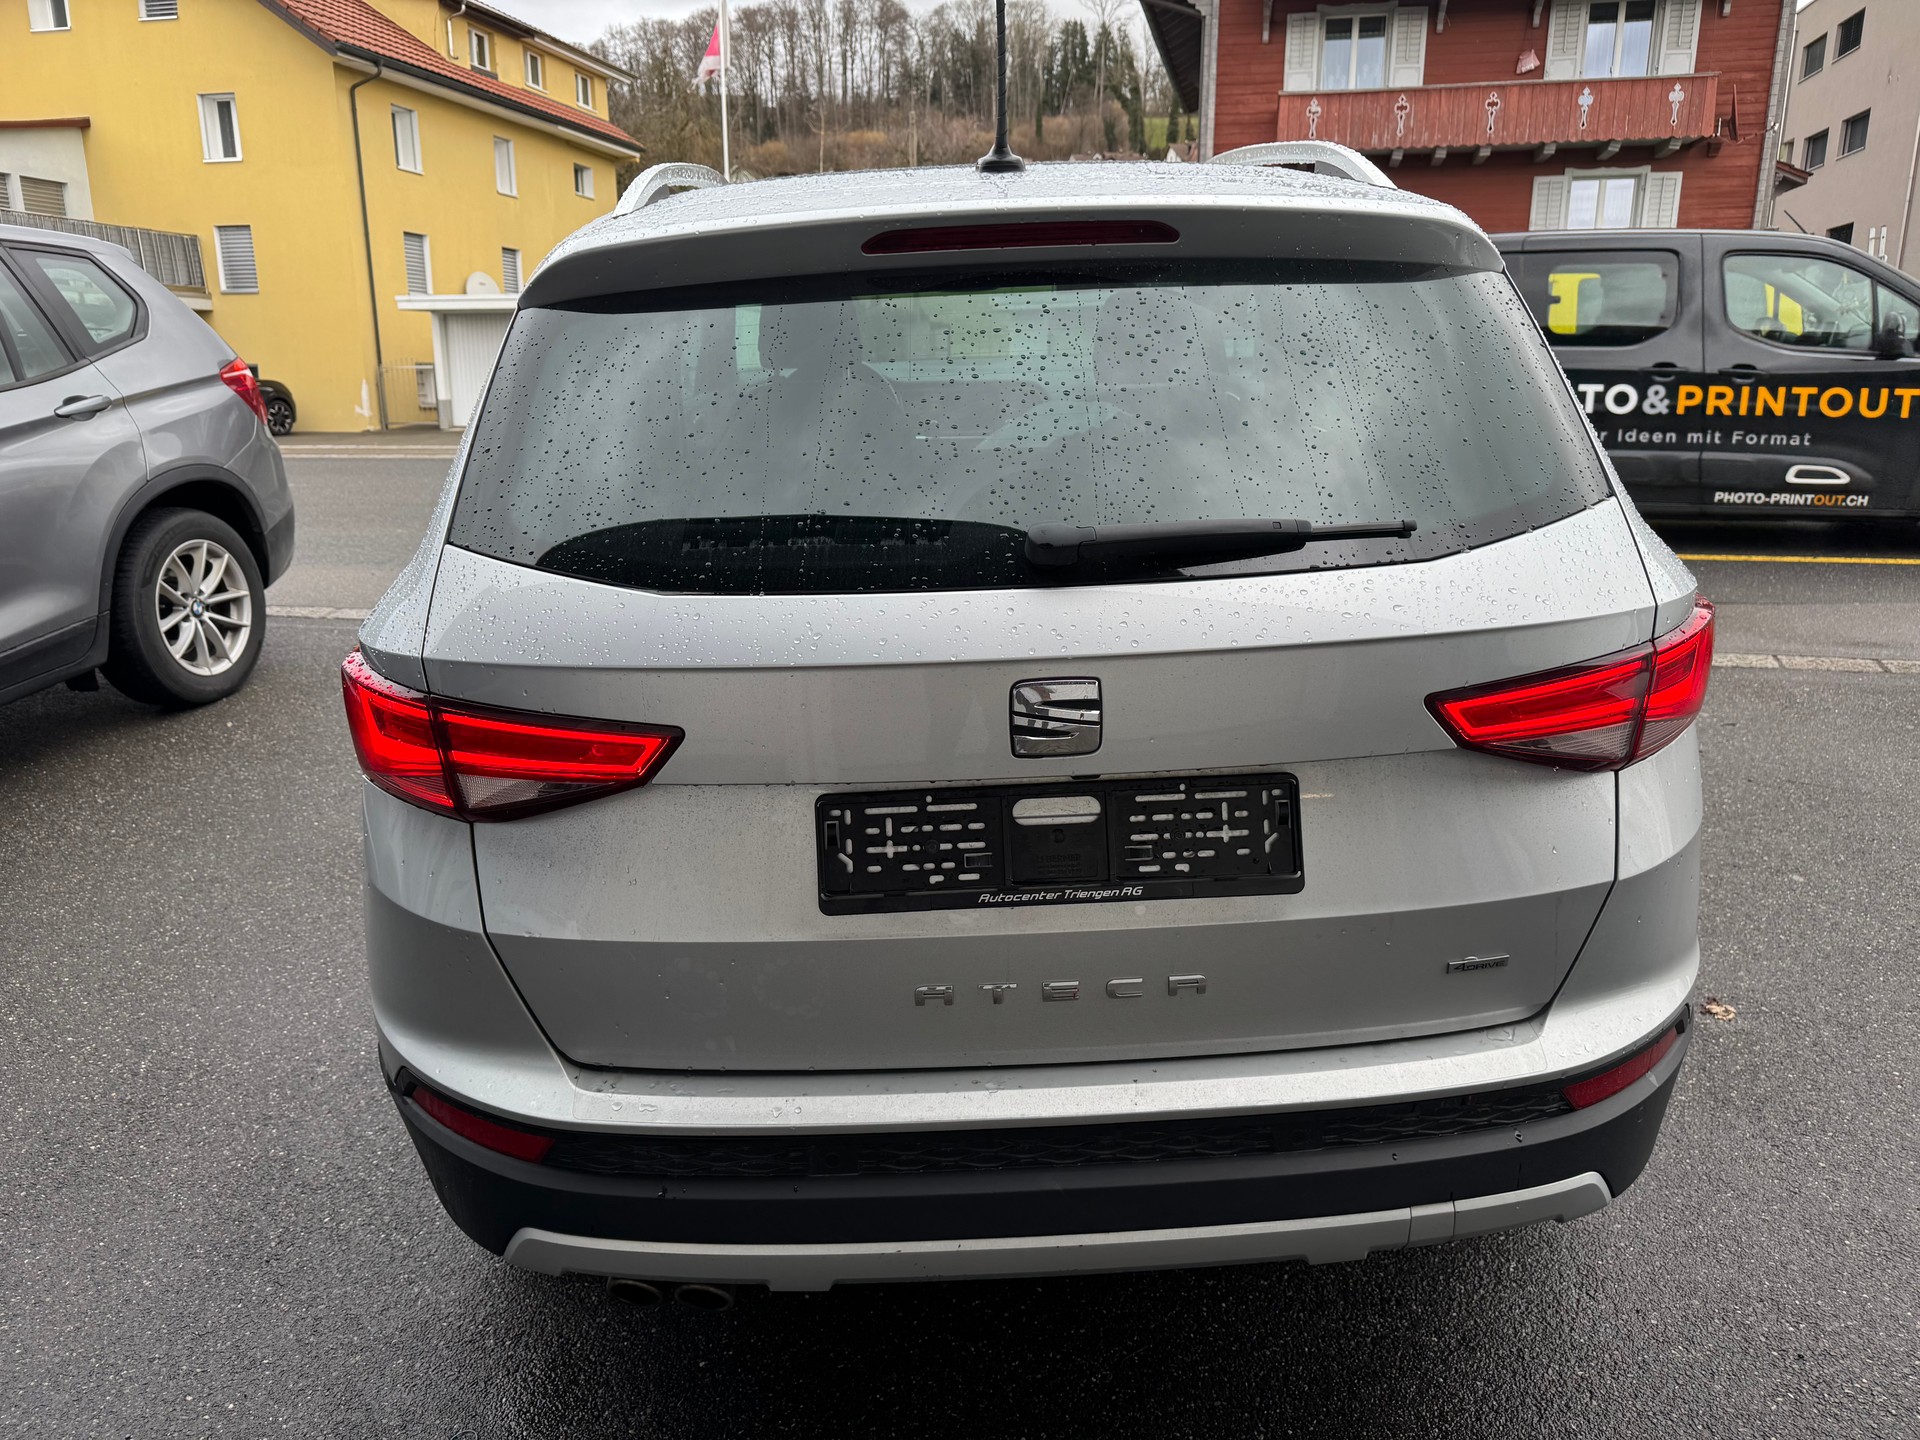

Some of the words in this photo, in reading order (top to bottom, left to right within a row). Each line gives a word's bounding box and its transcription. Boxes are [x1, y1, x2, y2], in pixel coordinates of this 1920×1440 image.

[1577, 383, 1920, 418] TO&PRINTOUT
[1617, 428, 1677, 443] Ideen
[1686, 430, 1721, 444] mit
[1732, 431, 1811, 446] Format
[1714, 491, 1868, 506] PHOTO-PRINTOUT.CH
[978, 891, 1061, 904] Autocenter
[1064, 888, 1119, 900] Triengen
[1121, 886, 1143, 896] AG
[1453, 960, 1505, 972] 4DRIVE
[914, 974, 1206, 1006] ATECA
